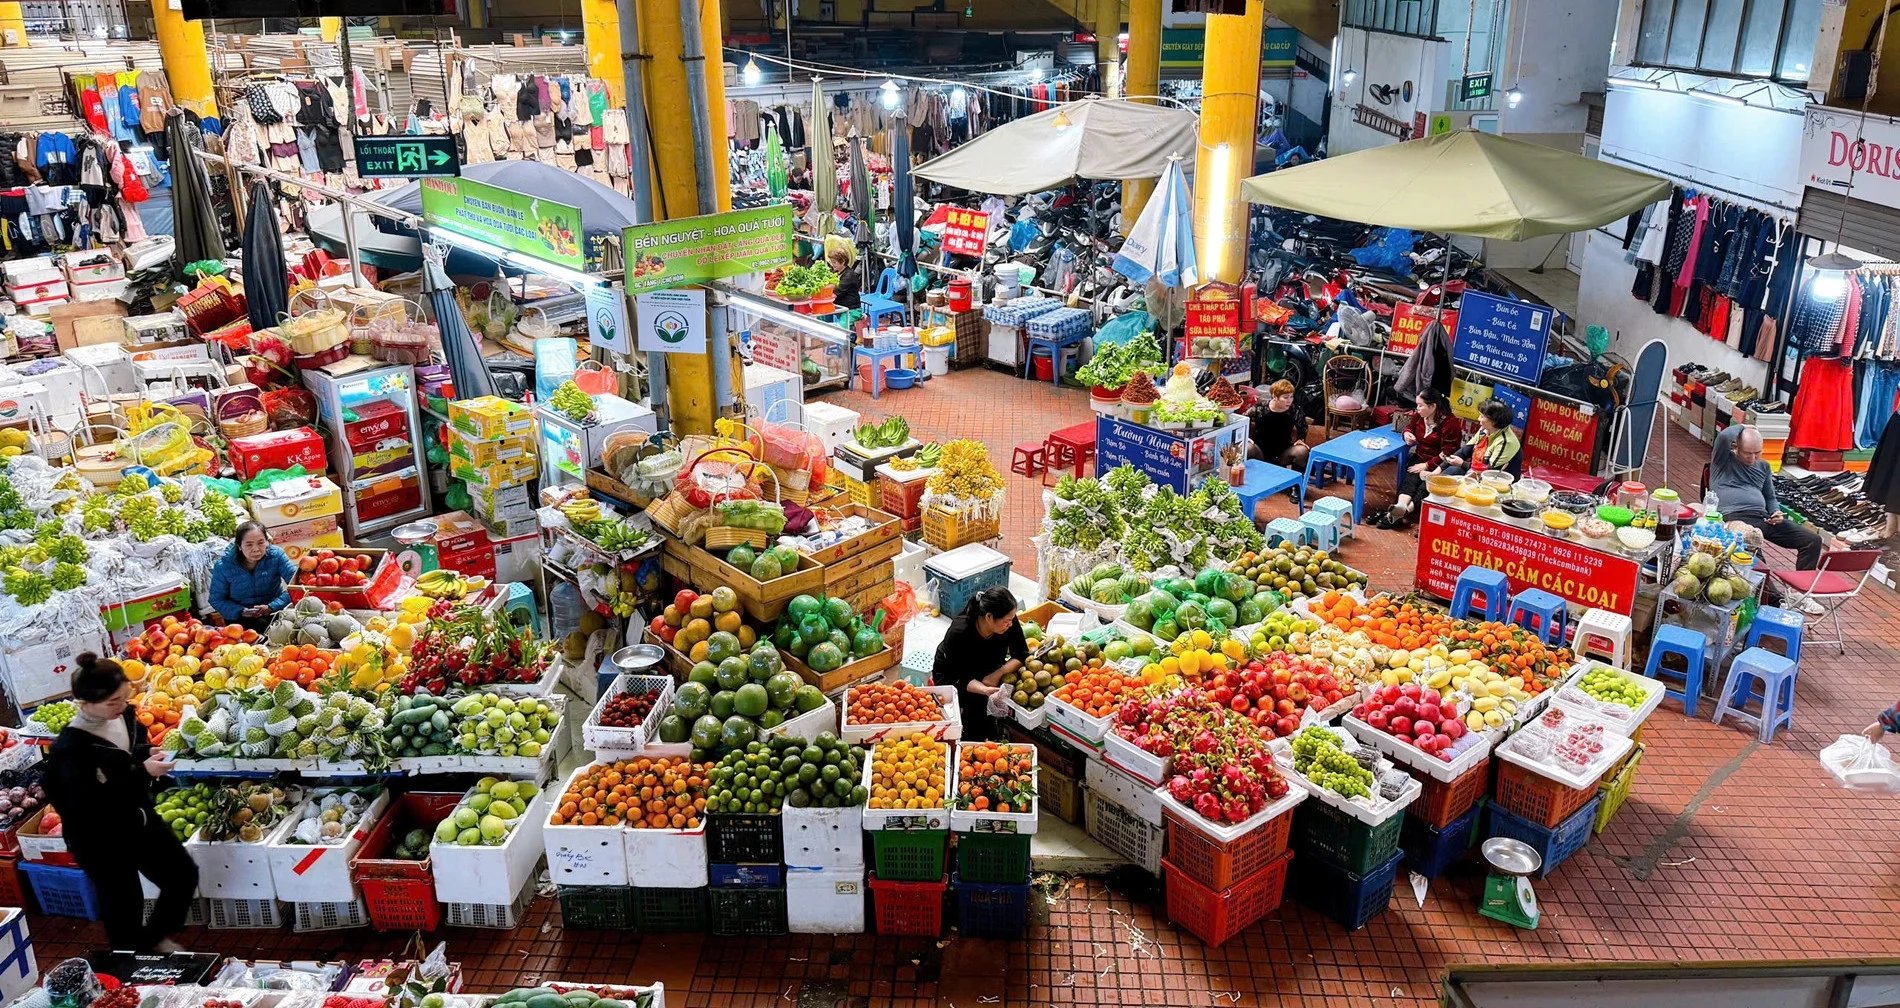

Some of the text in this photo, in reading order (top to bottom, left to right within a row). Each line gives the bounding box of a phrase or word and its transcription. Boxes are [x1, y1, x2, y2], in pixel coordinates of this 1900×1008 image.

[1469, 77, 1488, 88] EXIT
[360, 144, 396, 155] LỐI THOÁT
[366, 161, 394, 170] EXIT
[661, 229, 705, 246] NGUYỆT
[713, 224, 736, 237] HOA
[761, 216, 785, 231] TƯƠI
[1398, 316, 1423, 332] ĐẶC
[1479, 355, 1490, 366] 091
[1491, 359, 1503, 370] 662
[1504, 362, 1520, 375] 7473
[1457, 394, 1474, 408] 60
[360, 423, 380, 435] envy
[1539, 419, 1583, 443] THẬP CẨM
[1527, 434, 1590, 466] BÁNH BỘT LỌC
[281, 528, 303, 538] PEARS
[1457, 528, 1473, 540] STK:
[1501, 531, 1523, 544] 09166
[1524, 537, 1547, 551] 27473
[1553, 545, 1572, 558] 0926
[1573, 552, 1582, 561] 11
[1584, 555, 1603, 568] 5239
[1431, 538, 1460, 559] CHÈ
[1505, 556, 1540, 585] CẨM
[1541, 572, 1575, 596] CÁC
[1576, 582, 1618, 610] LOẠI
